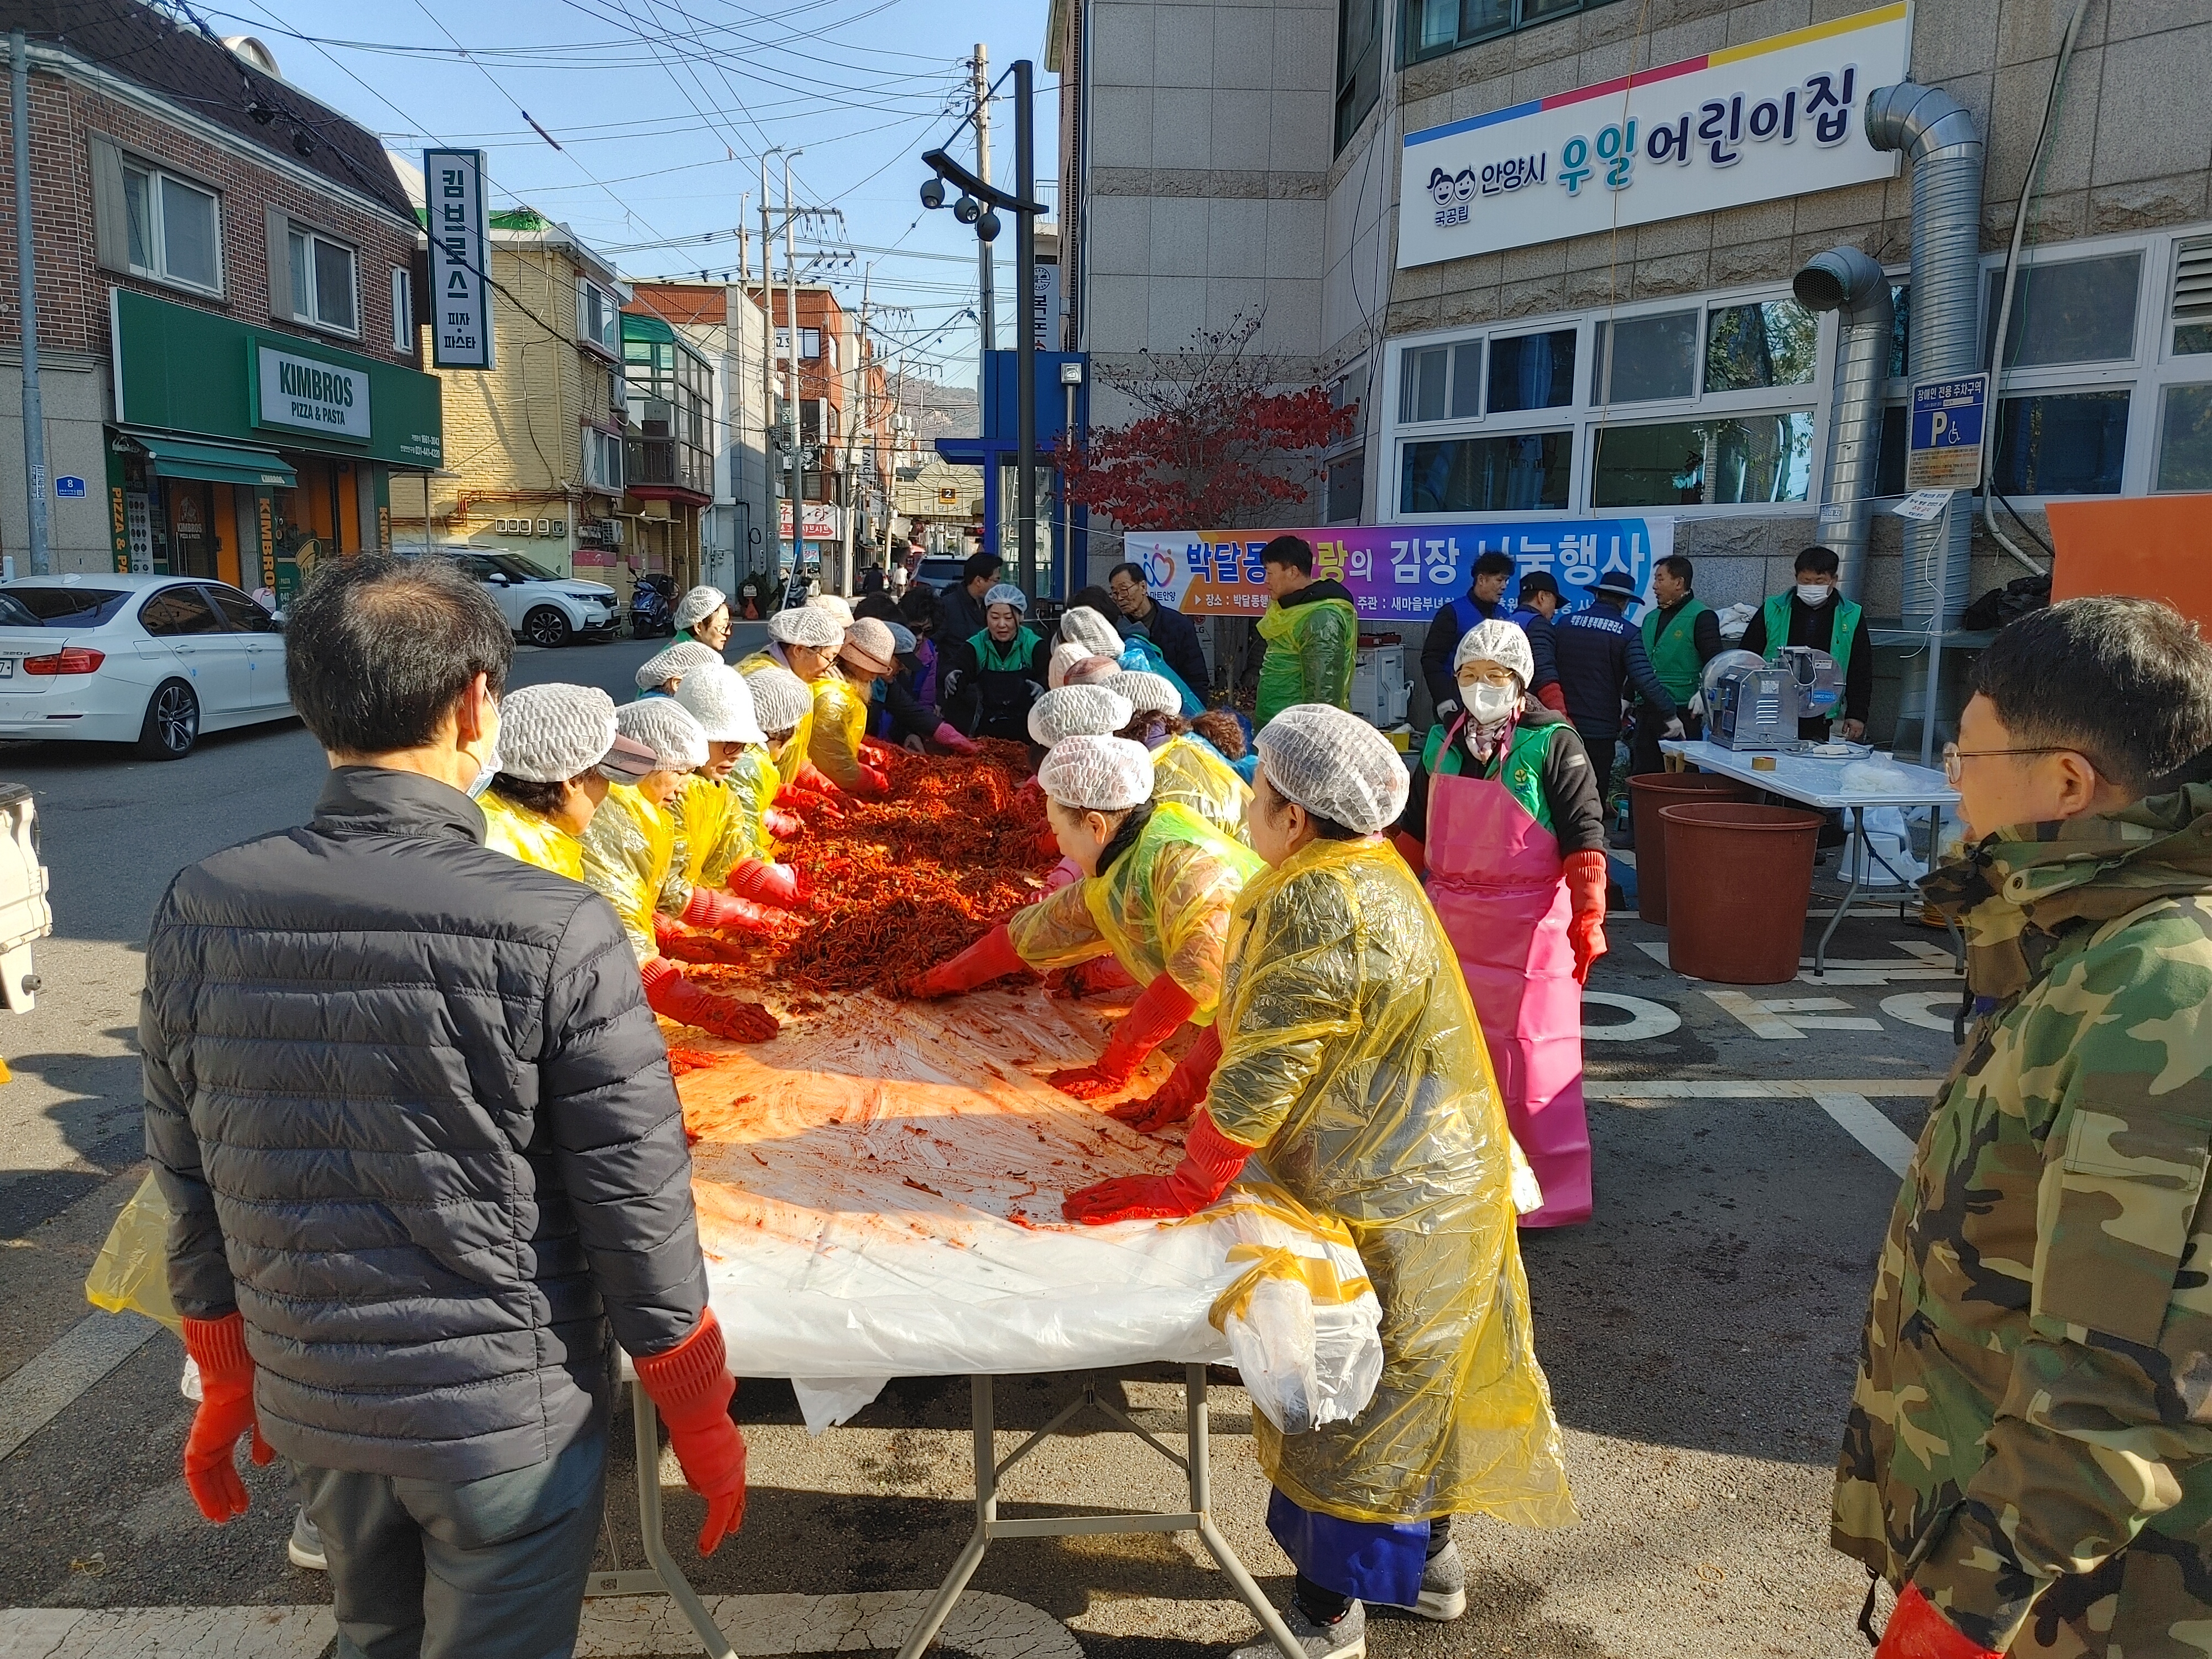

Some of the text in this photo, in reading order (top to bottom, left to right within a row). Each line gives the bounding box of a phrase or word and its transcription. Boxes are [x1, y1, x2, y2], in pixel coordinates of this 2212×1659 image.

[1481, 67, 1855, 194] 안양시 우일 어린이집
[1434, 205, 1469, 225] 국공립
[442, 170, 468, 299] 킴브로스
[447, 312, 469, 326] 피자
[444, 335, 476, 349] 파스타
[279, 361, 353, 408] KIMBROS
[1917, 380, 1982, 401] 장애인 전용 주차구역
[291, 401, 346, 425] PIZZA & PASTA
[1931, 411, 1947, 446] P
[67, 479, 74, 488] 8
[945, 489, 952, 498] 2
[112, 487, 124, 534] PIZZA
[177, 523, 202, 533] KIMBROS
[1186, 540, 1268, 585] 박달동
[1307, 540, 1373, 585] 랑의
[1390, 536, 1460, 585] 김장
[1206, 593, 1223, 607] 장소
[1233, 594, 1271, 608] 박달동행
[1357, 596, 1378, 611] 주관
